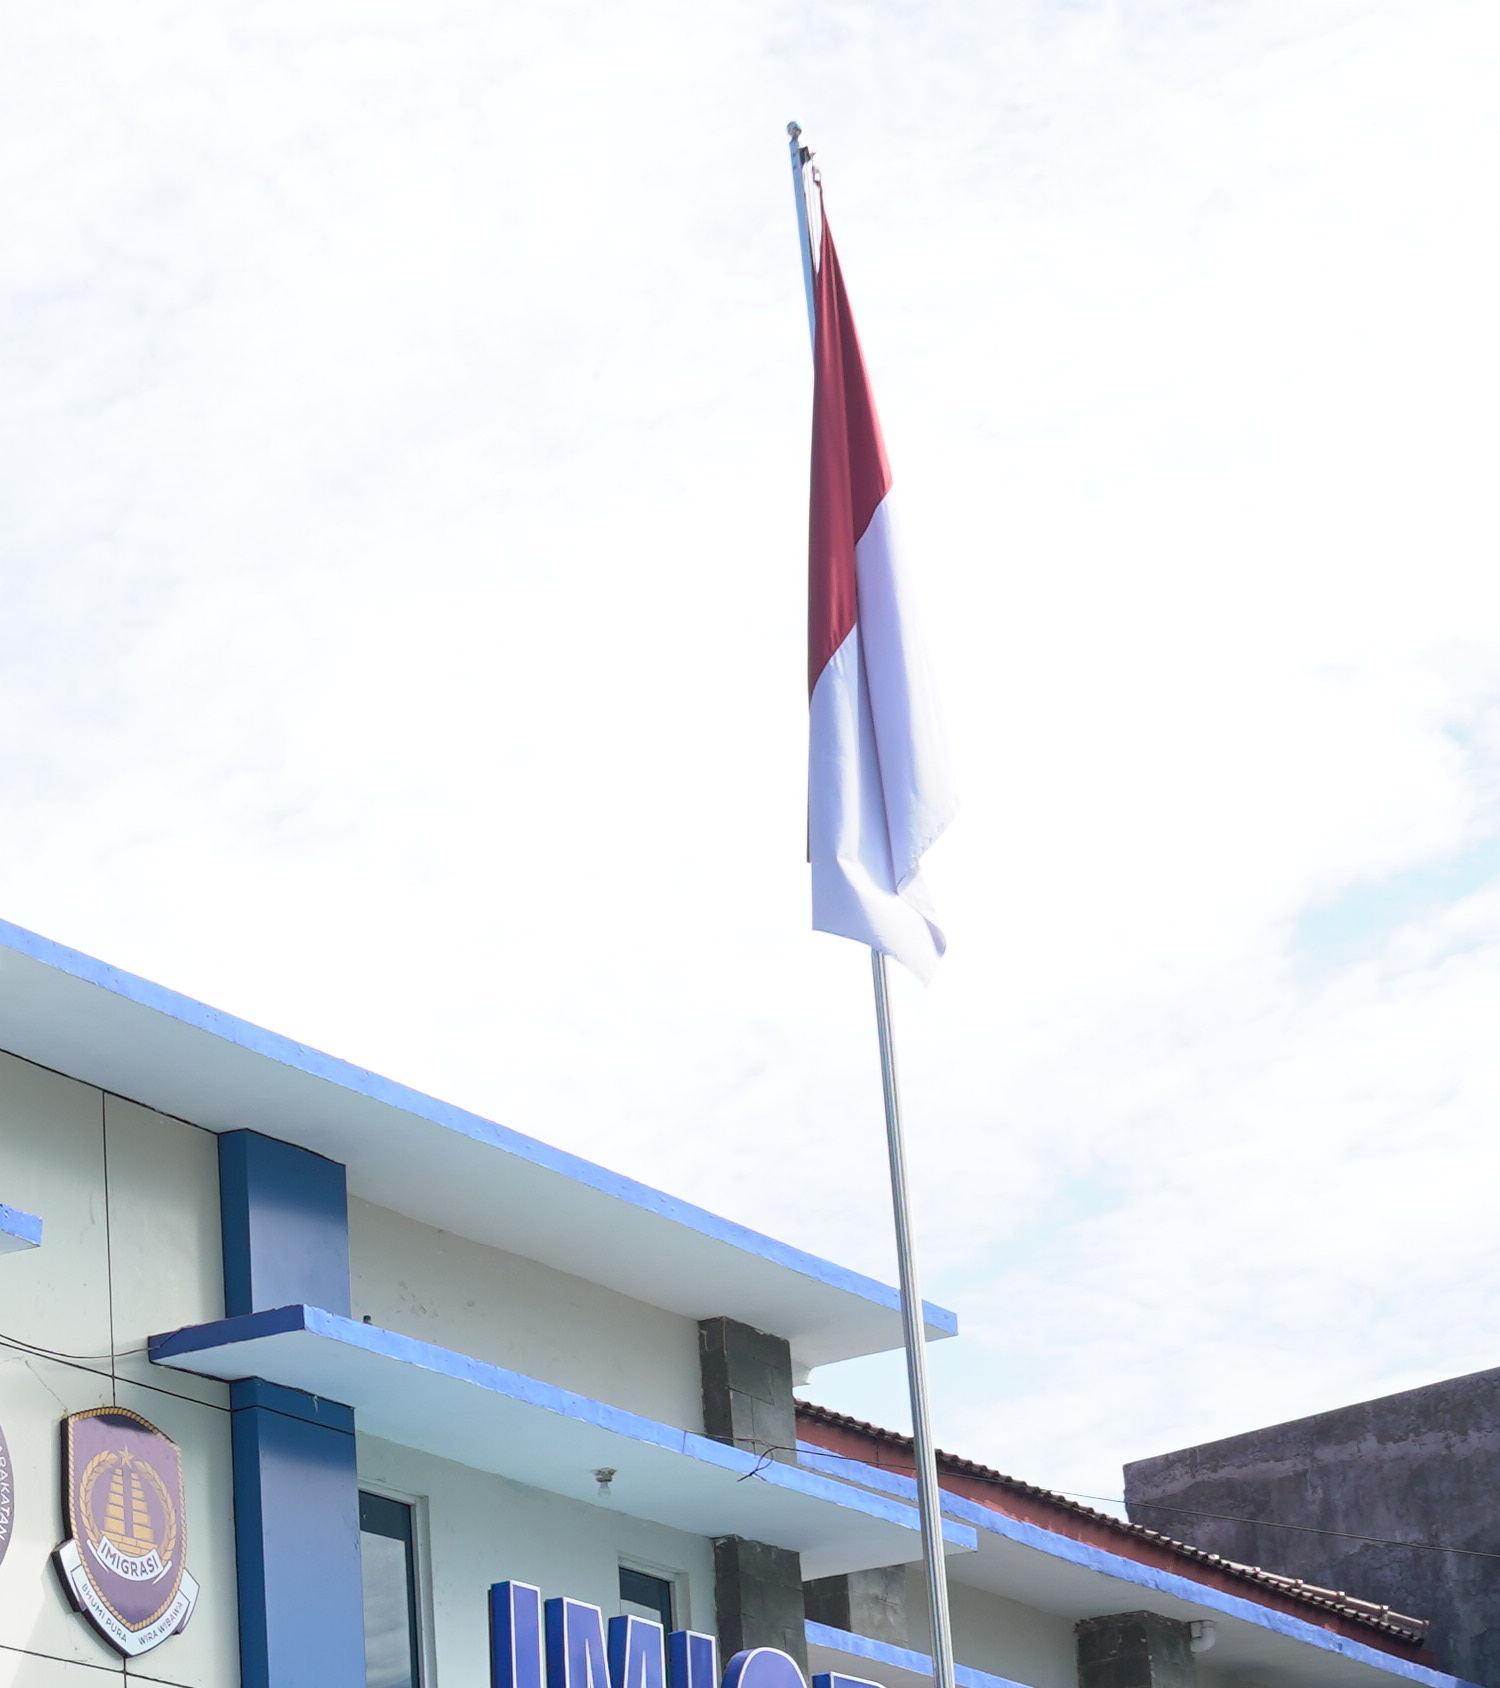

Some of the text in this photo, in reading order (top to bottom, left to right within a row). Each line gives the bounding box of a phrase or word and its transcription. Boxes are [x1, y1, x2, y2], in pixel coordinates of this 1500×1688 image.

[101, 1541, 159, 1577] IMIGRASI
[81, 1583, 106, 1620] BHUMI
[105, 1618, 127, 1643] PURA
[137, 1629, 158, 1646] WIRA
